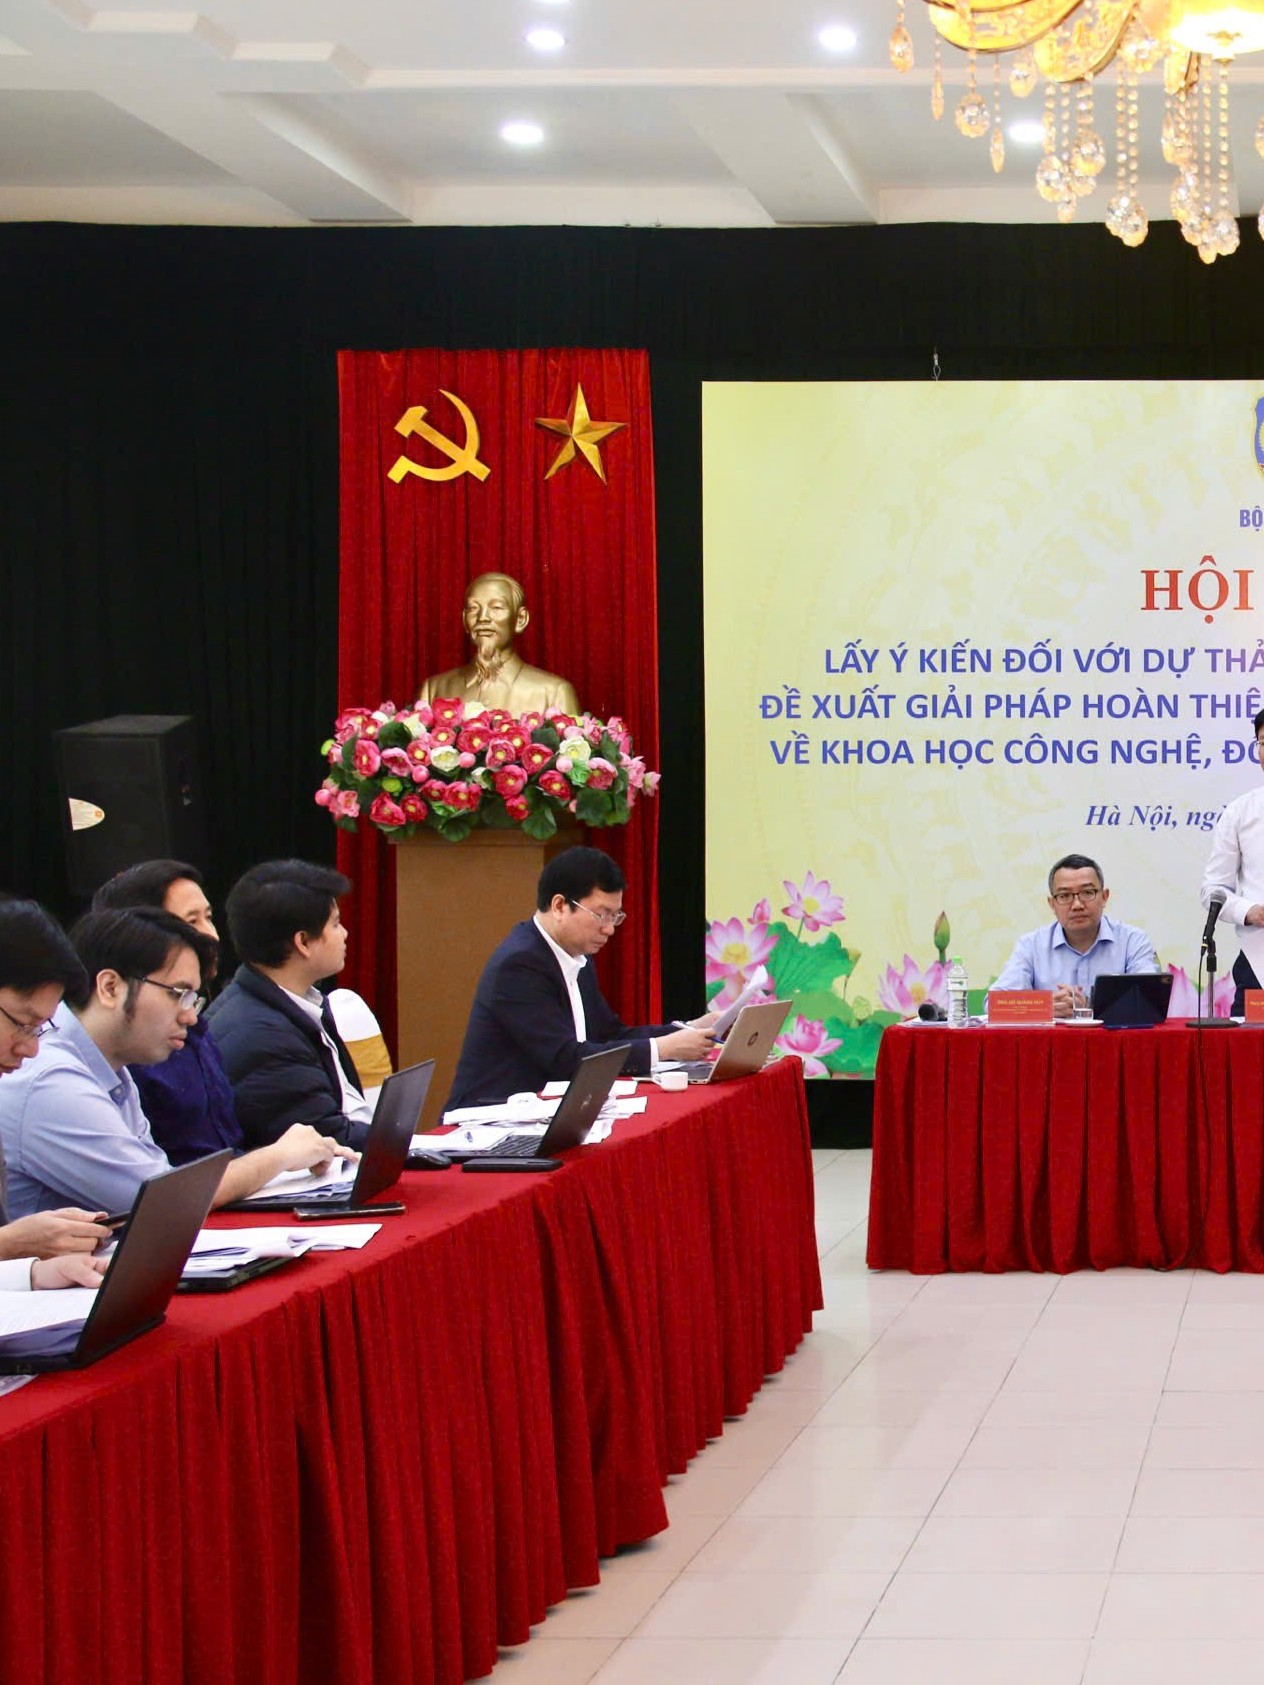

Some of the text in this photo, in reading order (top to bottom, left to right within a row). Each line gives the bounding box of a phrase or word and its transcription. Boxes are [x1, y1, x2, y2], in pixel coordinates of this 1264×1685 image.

[1240, 505, 1263, 531] BỘ
[1141, 555, 1254, 624] HỘI
[825, 639, 880, 673] LẤY
[889, 642, 908, 673] Ý
[920, 638, 991, 673] KIẾN
[1002, 638, 1061, 673] ĐỐI
[1073, 642, 1130, 673] VỚI
[1144, 646, 1195, 678] DỰ
[759, 685, 801, 719] ĐỀ
[812, 684, 896, 719] XUẤT
[906, 684, 972, 719] GIẢI
[985, 687, 1071, 719] PHÁP
[1083, 687, 1178, 719] HOÀN
[770, 730, 809, 764] VỀ
[822, 739, 914, 764] KHOA
[925, 739, 994, 770] HỌC
[1004, 733, 1098, 764] CÔNG
[1111, 733, 1211, 770] NGHỆ,
[1085, 805, 1121, 827] Hà
[1129, 805, 1177, 832] Nội,
[1186, 805, 1227, 831] ng
